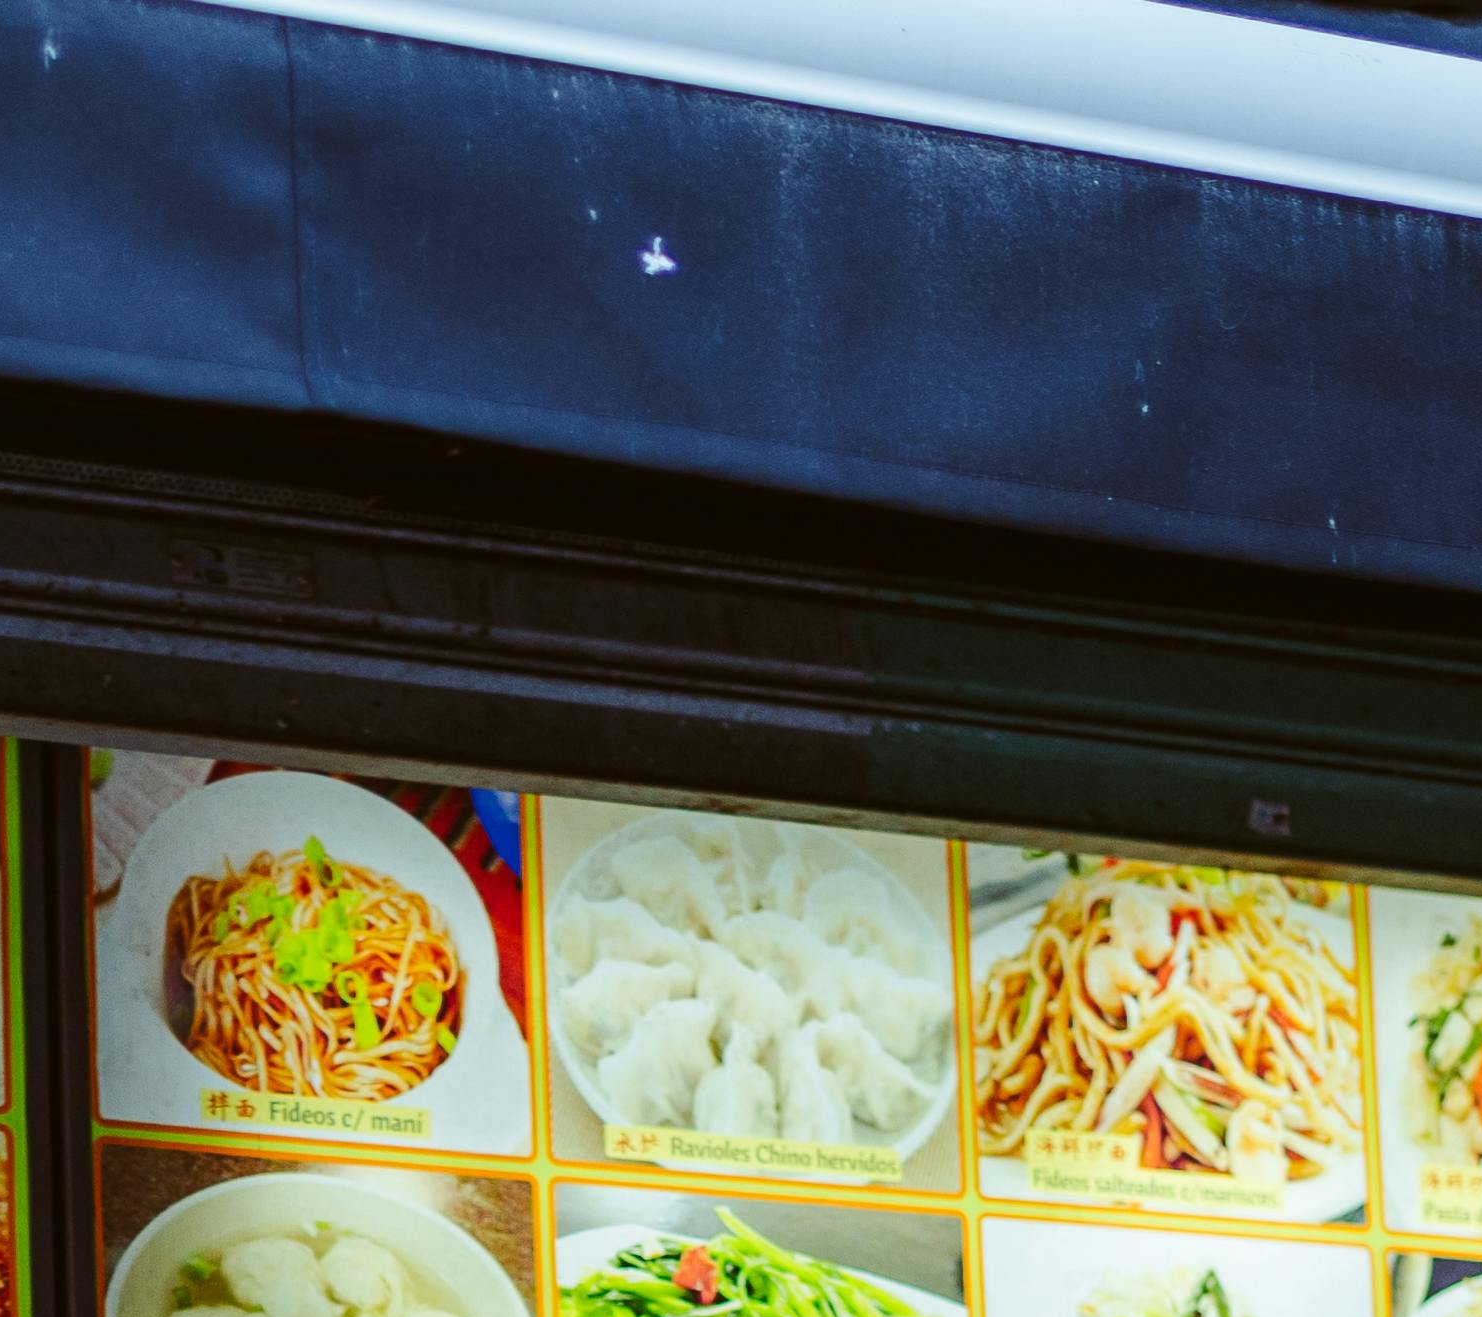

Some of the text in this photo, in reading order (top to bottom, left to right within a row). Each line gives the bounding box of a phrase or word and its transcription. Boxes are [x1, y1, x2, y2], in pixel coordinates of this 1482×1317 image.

[268, 1101, 337, 1126] Fideos
[670, 1137, 899, 1176] Ravioles Chino hervidos
